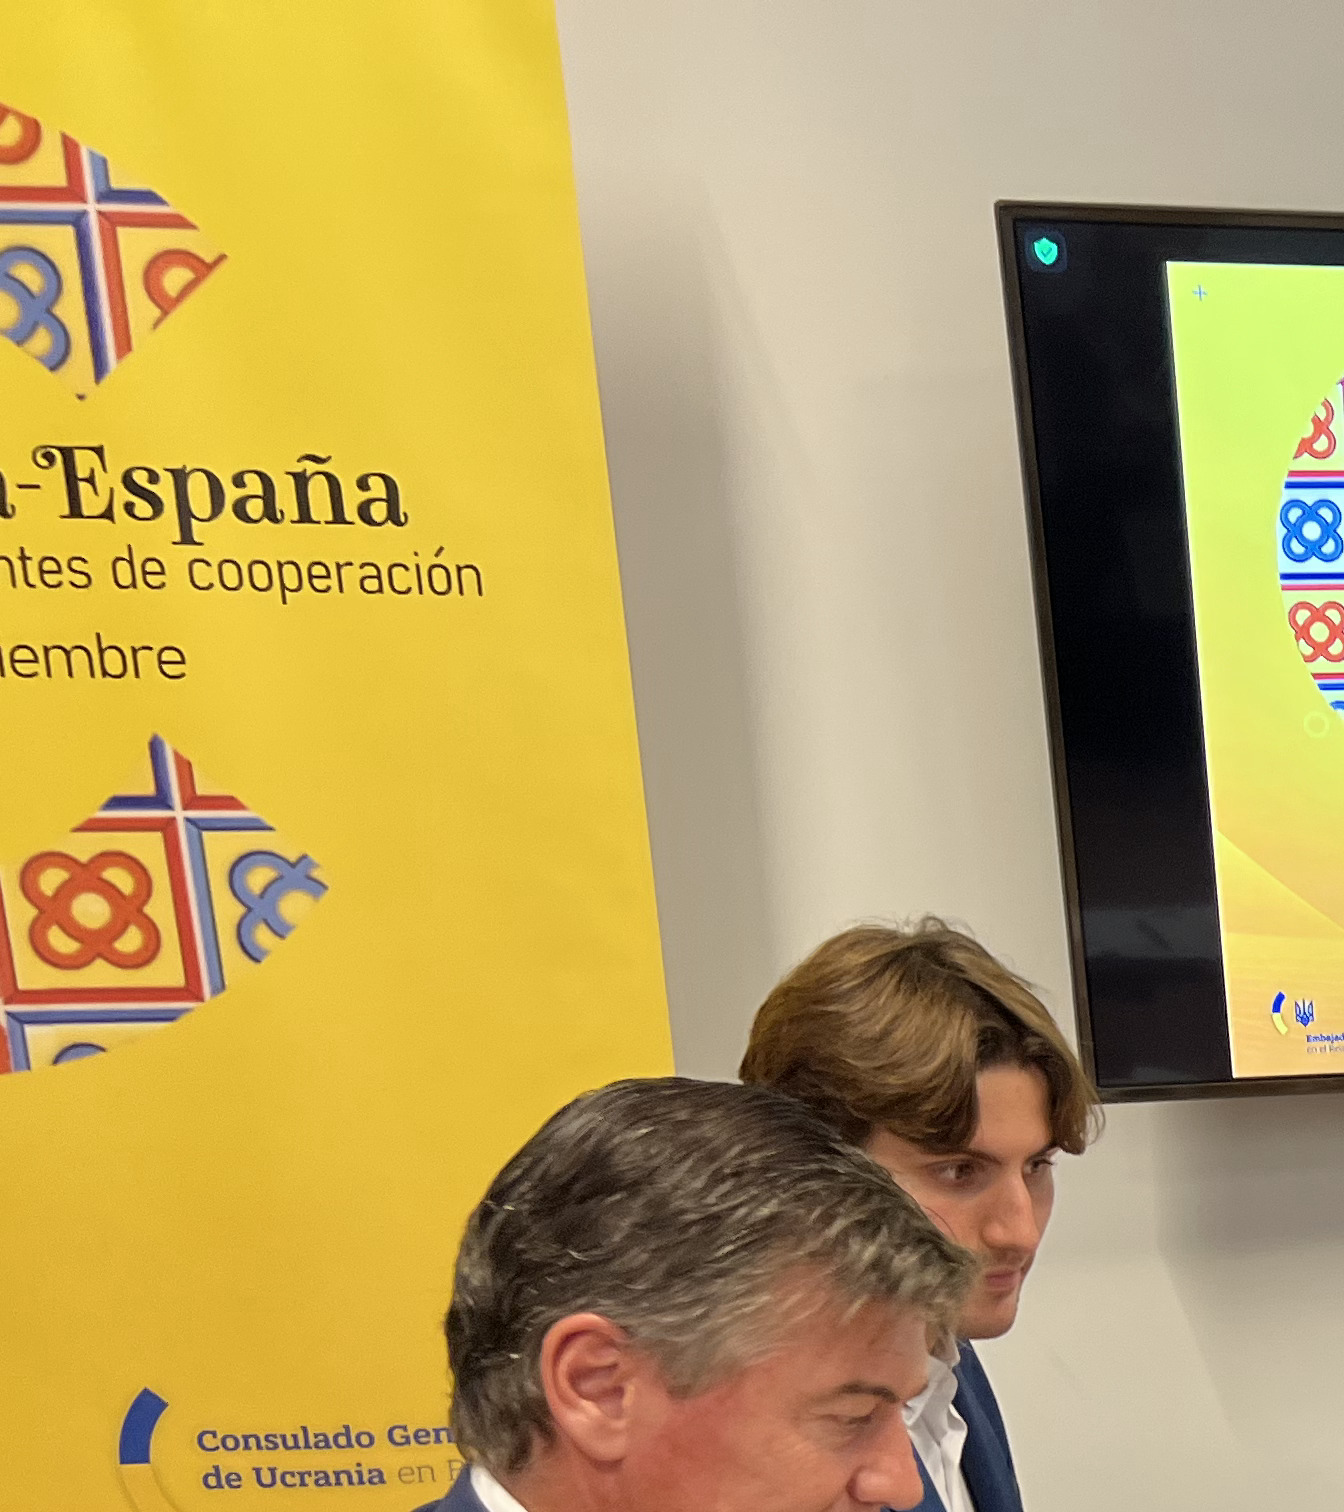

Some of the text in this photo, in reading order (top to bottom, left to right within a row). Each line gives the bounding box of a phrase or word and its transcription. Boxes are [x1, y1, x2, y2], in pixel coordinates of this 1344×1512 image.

[111, 545, 166, 591] de
[188, 546, 484, 605] cooperación
[196, 1424, 376, 1452] Consulado
[202, 1464, 243, 1490] de
[252, 1461, 387, 1489] Ucrania
[397, 1464, 436, 1484] en
